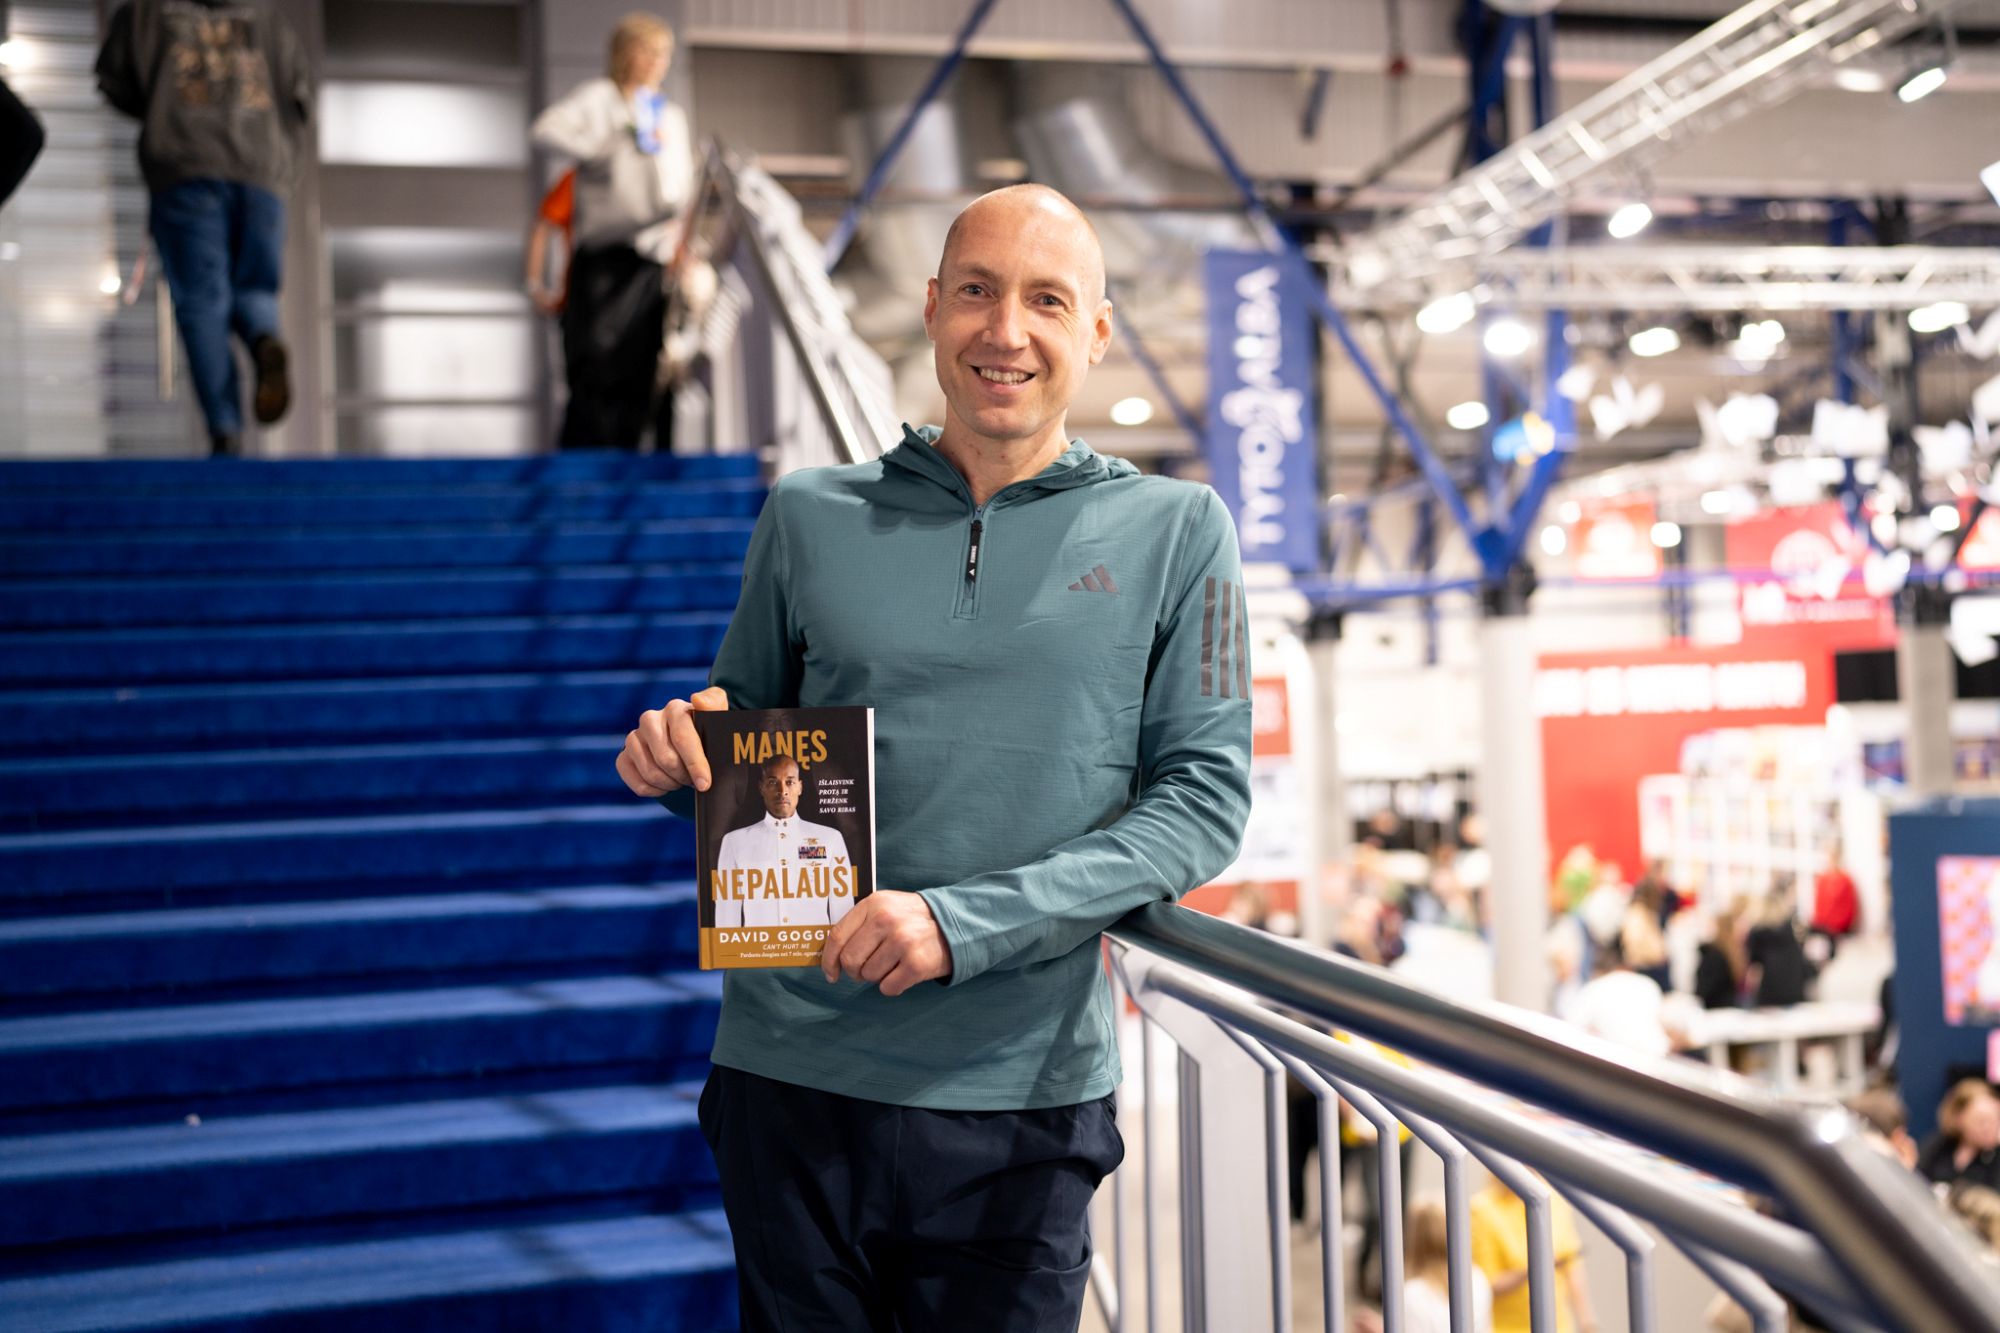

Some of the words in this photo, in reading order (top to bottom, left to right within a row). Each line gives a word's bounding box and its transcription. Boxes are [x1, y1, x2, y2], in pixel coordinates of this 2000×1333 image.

[733, 729, 828, 771] MANĘS
[818, 778, 855, 786] IŠLAISVINK
[818, 788, 840, 796] PROTĄ
[711, 856, 859, 901] NEPALAUŠI
[719, 931, 770, 943] DAVID
